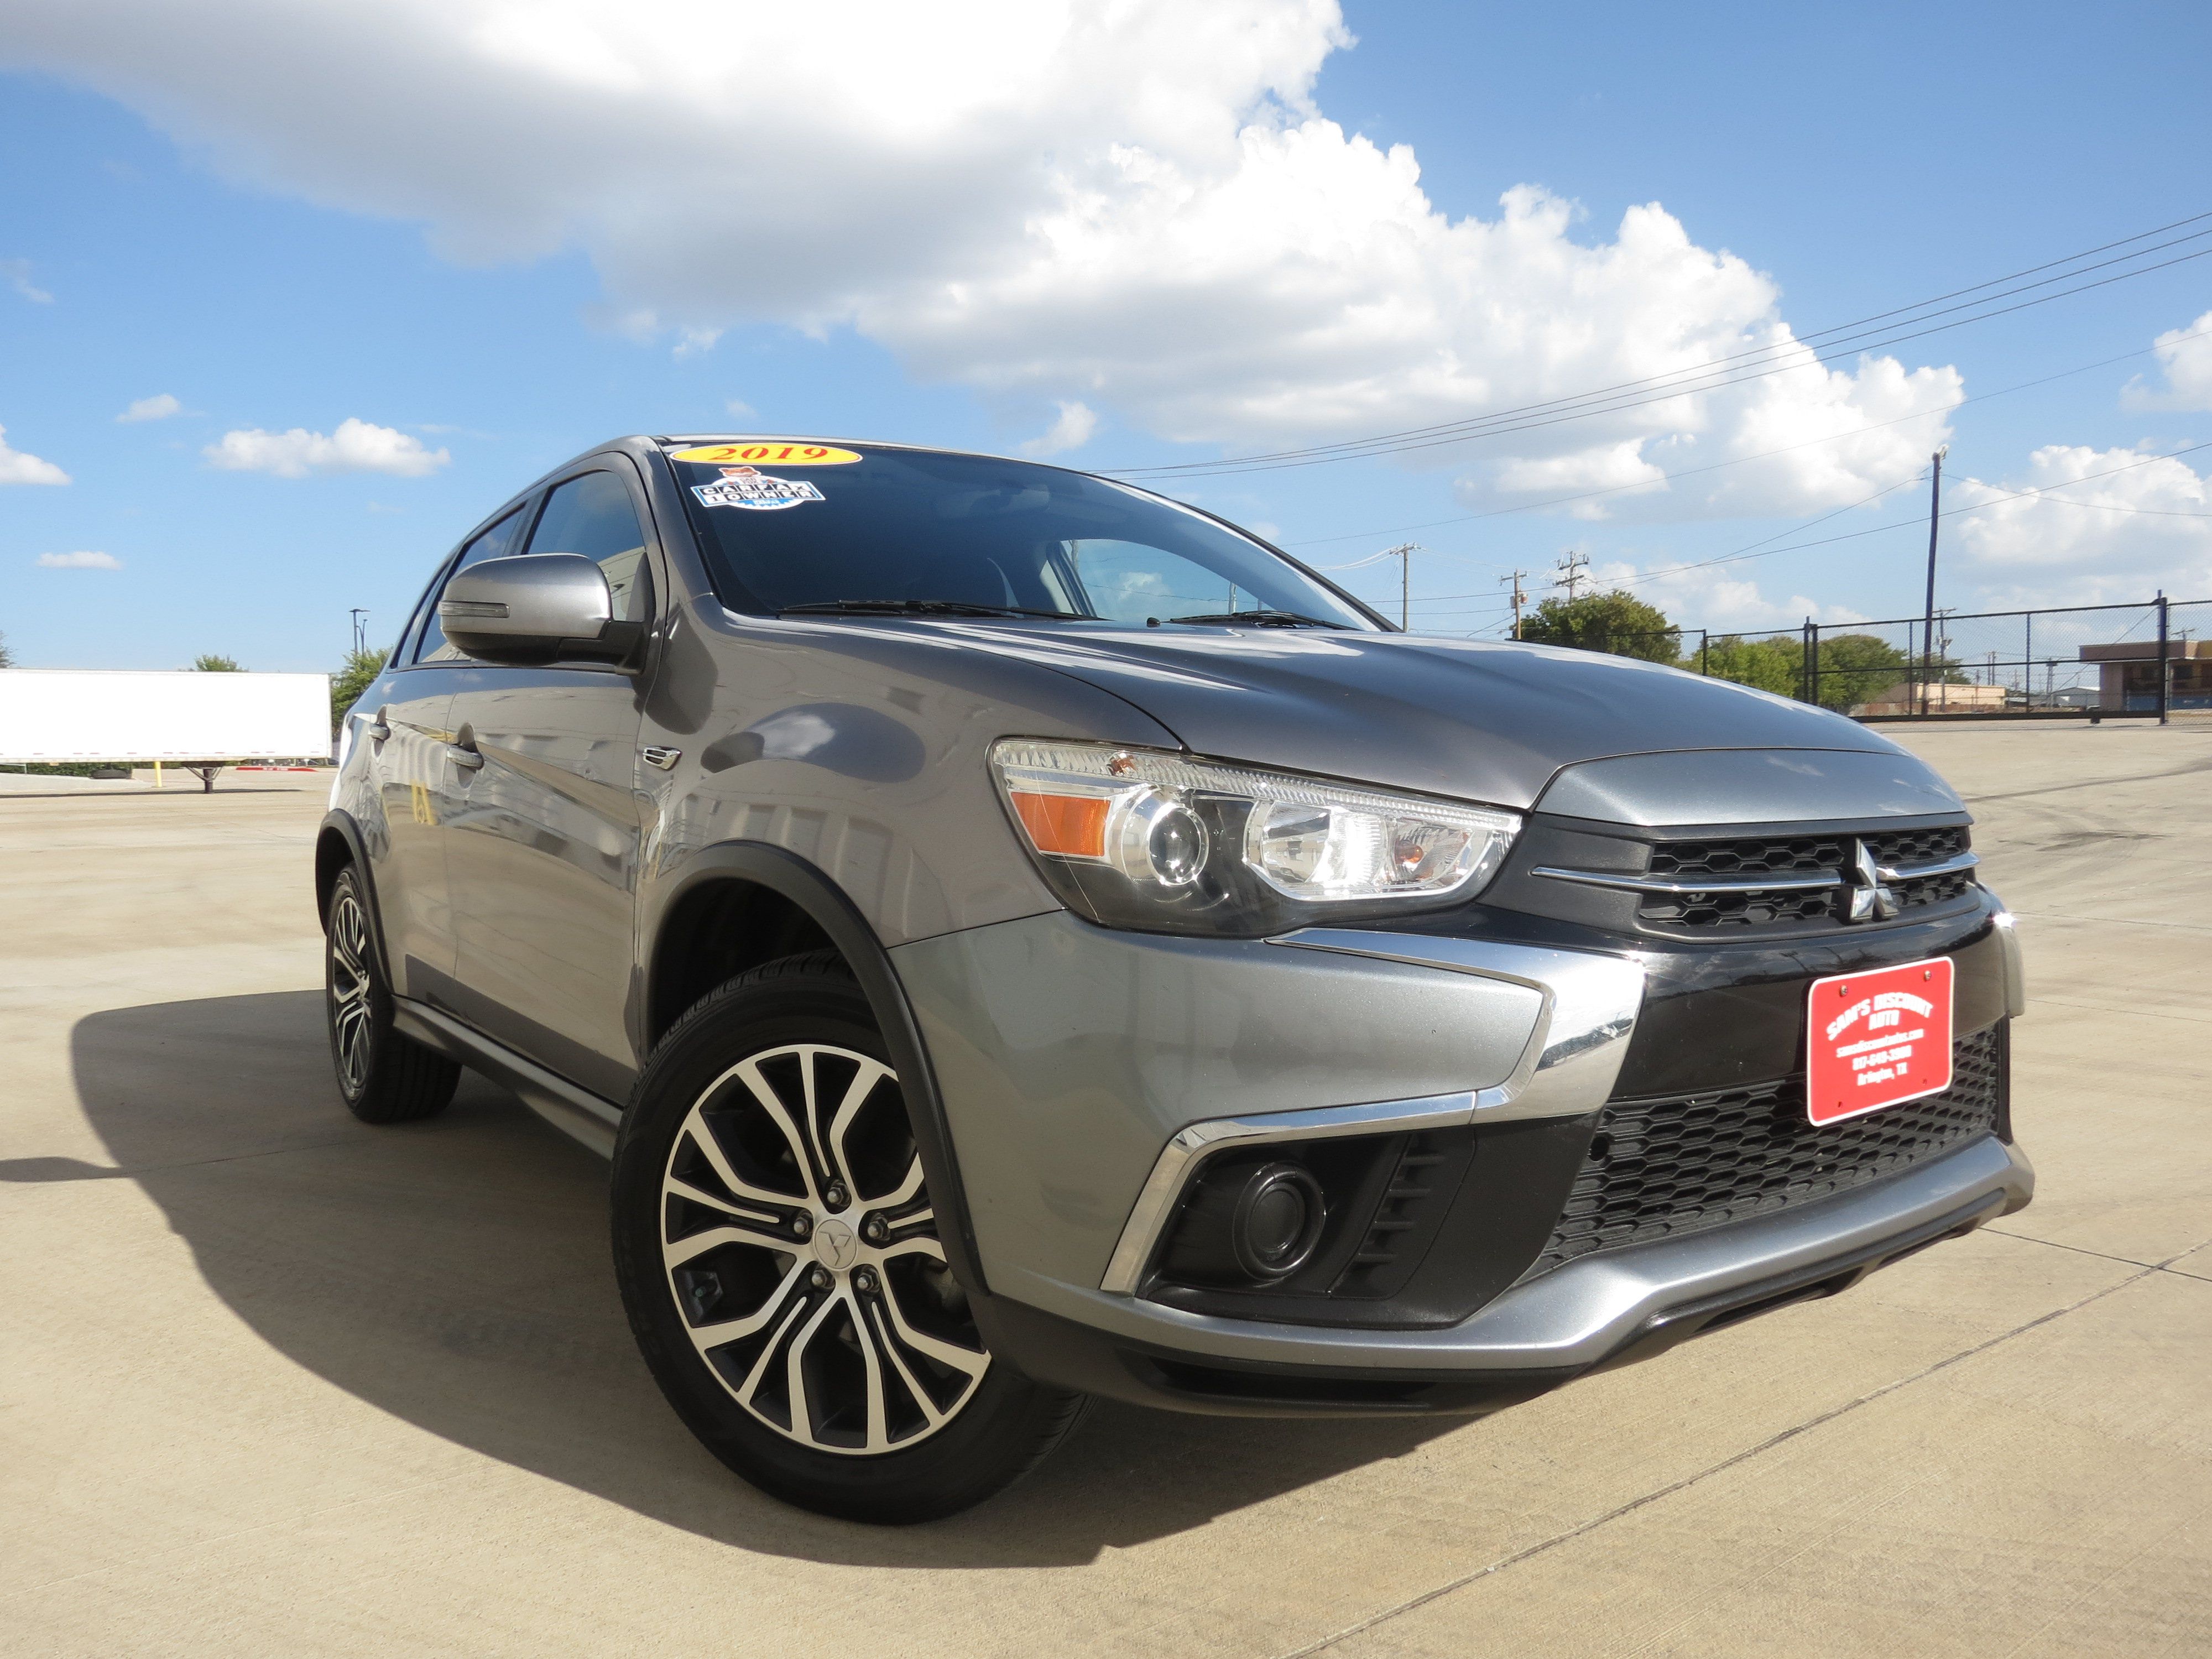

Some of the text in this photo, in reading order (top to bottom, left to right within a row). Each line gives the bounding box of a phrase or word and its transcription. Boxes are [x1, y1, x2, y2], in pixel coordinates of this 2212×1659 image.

[708, 447, 828, 460] 2019
[703, 484, 804, 494] CARFAX
[727, 491, 813, 500] OWNER
[1827, 993, 1933, 1041] SAM'S DISCOUNT
[1869, 1010, 1900, 1030] AUTO
